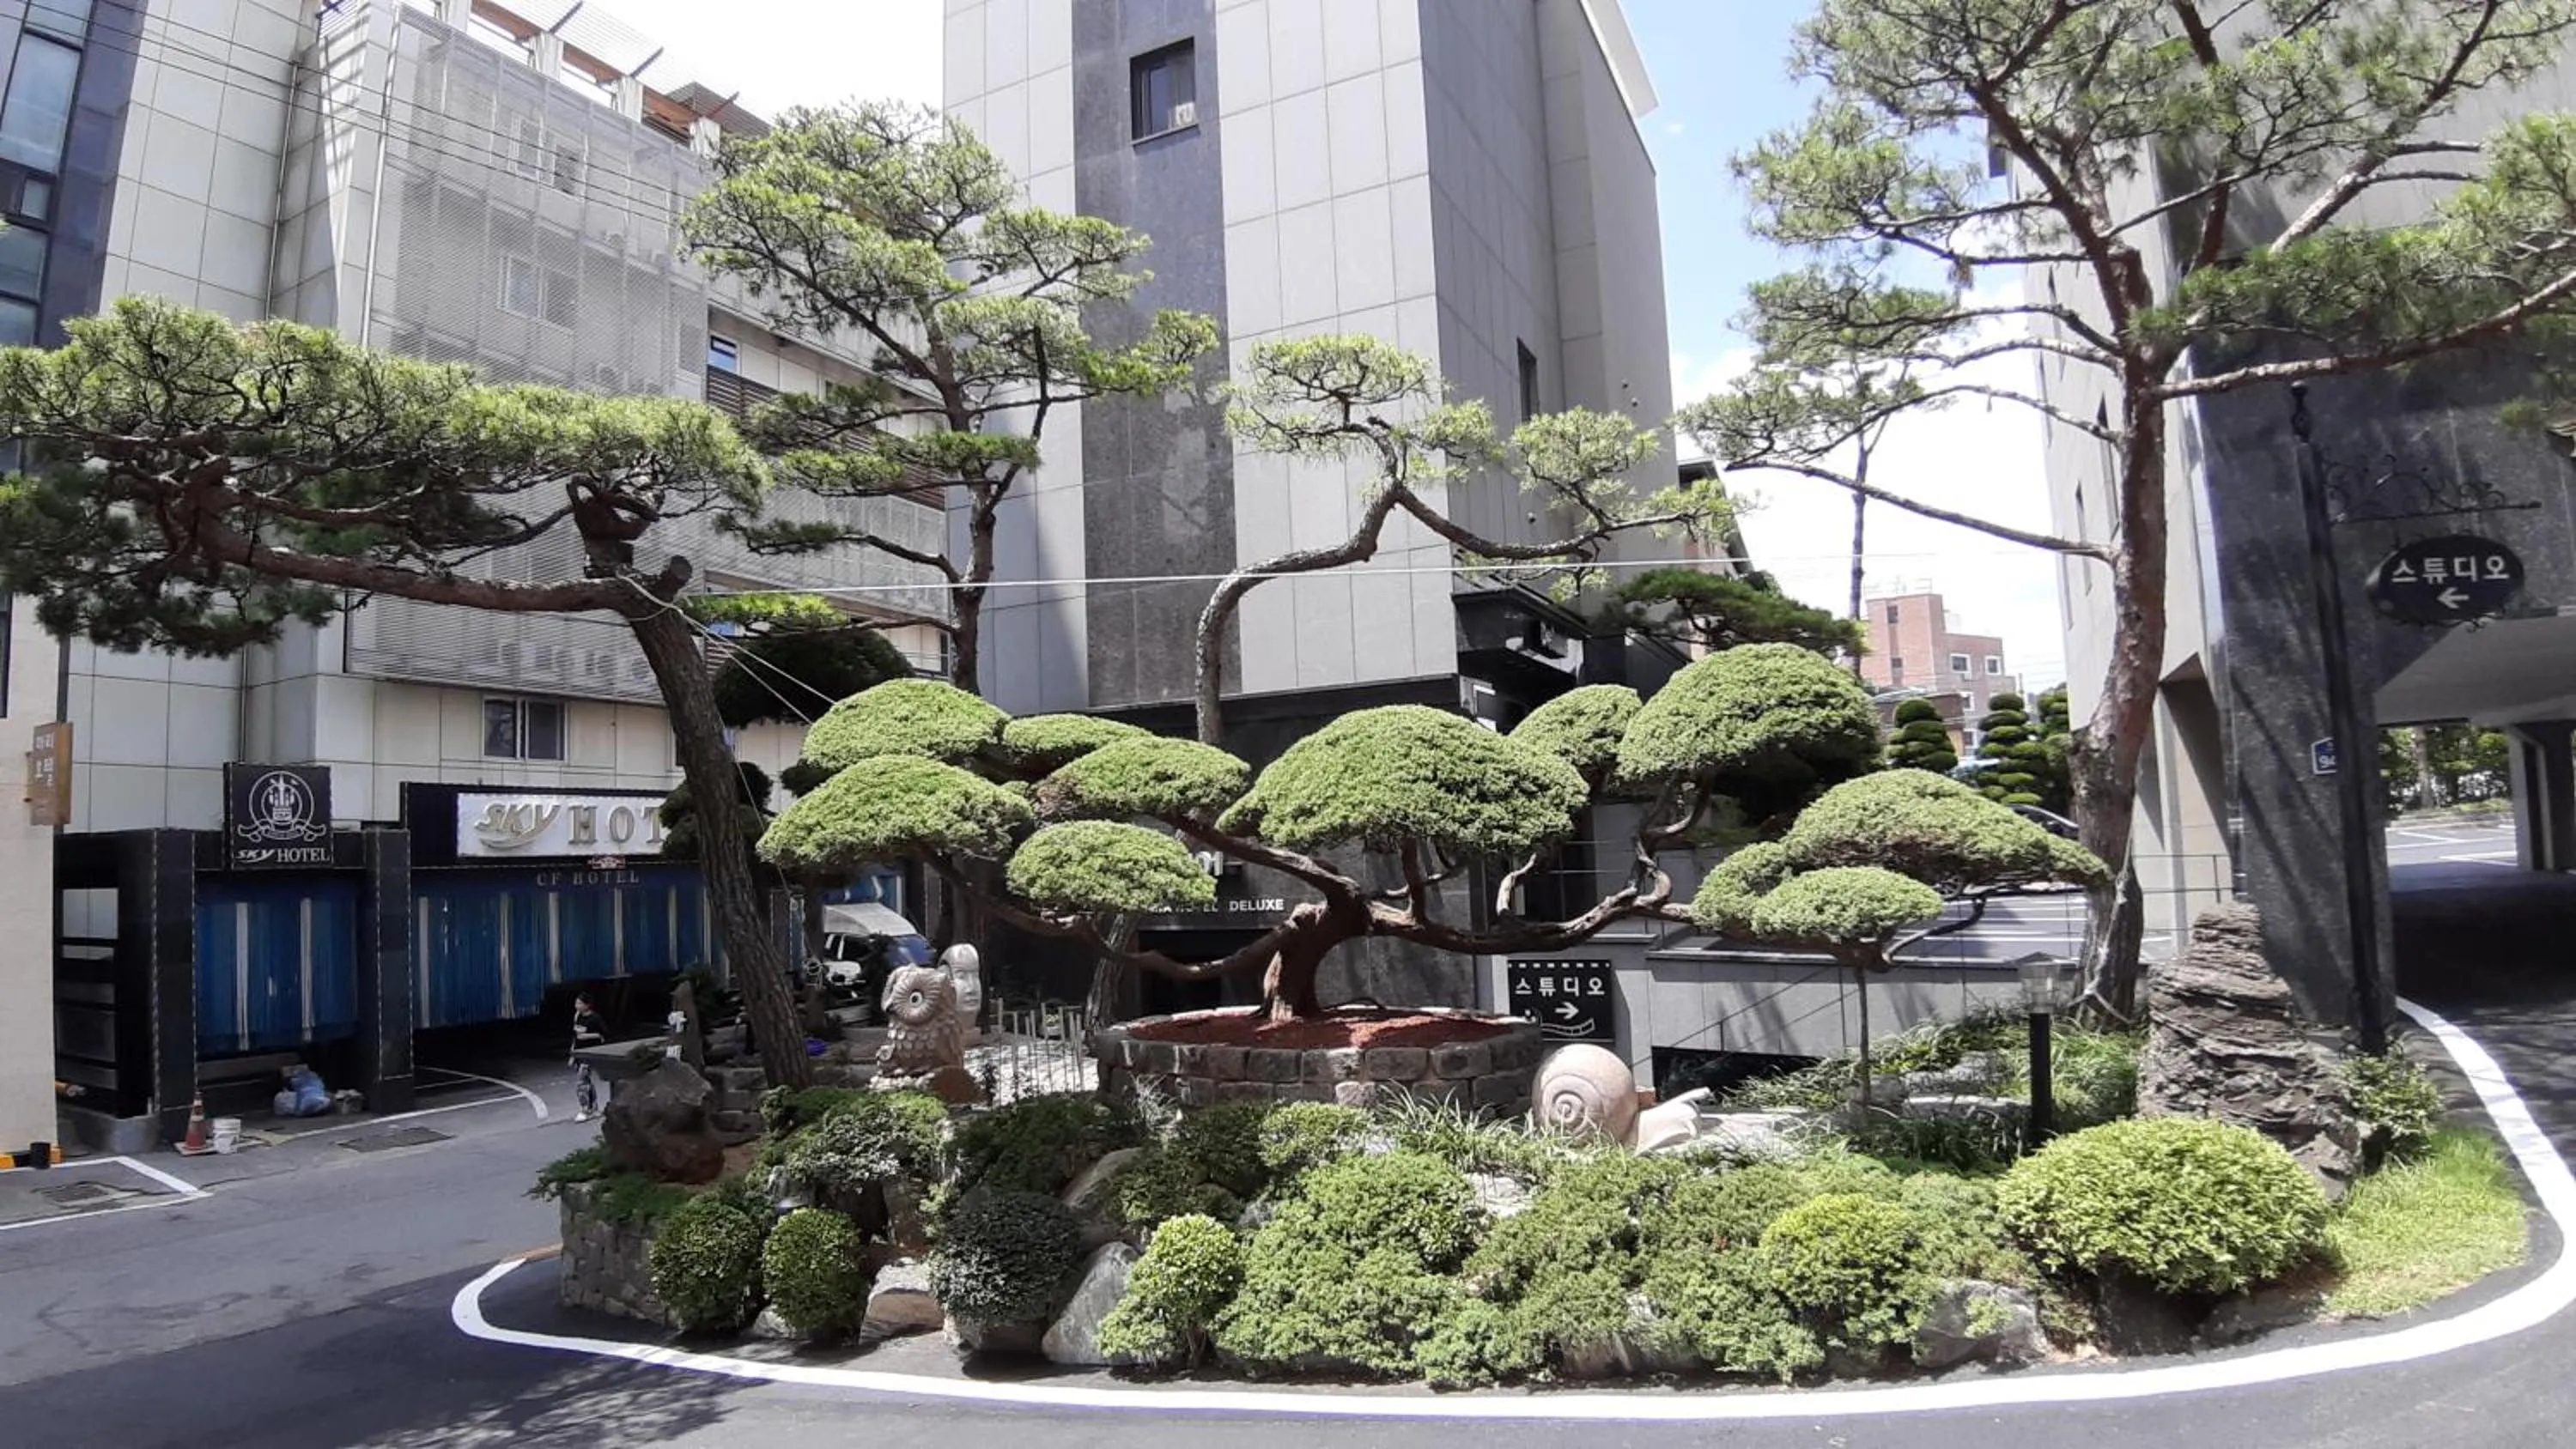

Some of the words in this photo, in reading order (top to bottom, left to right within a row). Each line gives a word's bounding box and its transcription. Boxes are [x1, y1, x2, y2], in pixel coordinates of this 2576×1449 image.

[2391, 556, 2510, 584] 스튜디오
[474, 803, 561, 850] SKY
[568, 804, 666, 846] HOT
[236, 848, 275, 863] SKY
[276, 847, 331, 863] HOTEL
[573, 870, 639, 885] HOTEL
[1229, 899, 1285, 912] DELUXE
[1515, 976, 1605, 997] 스튜디오
